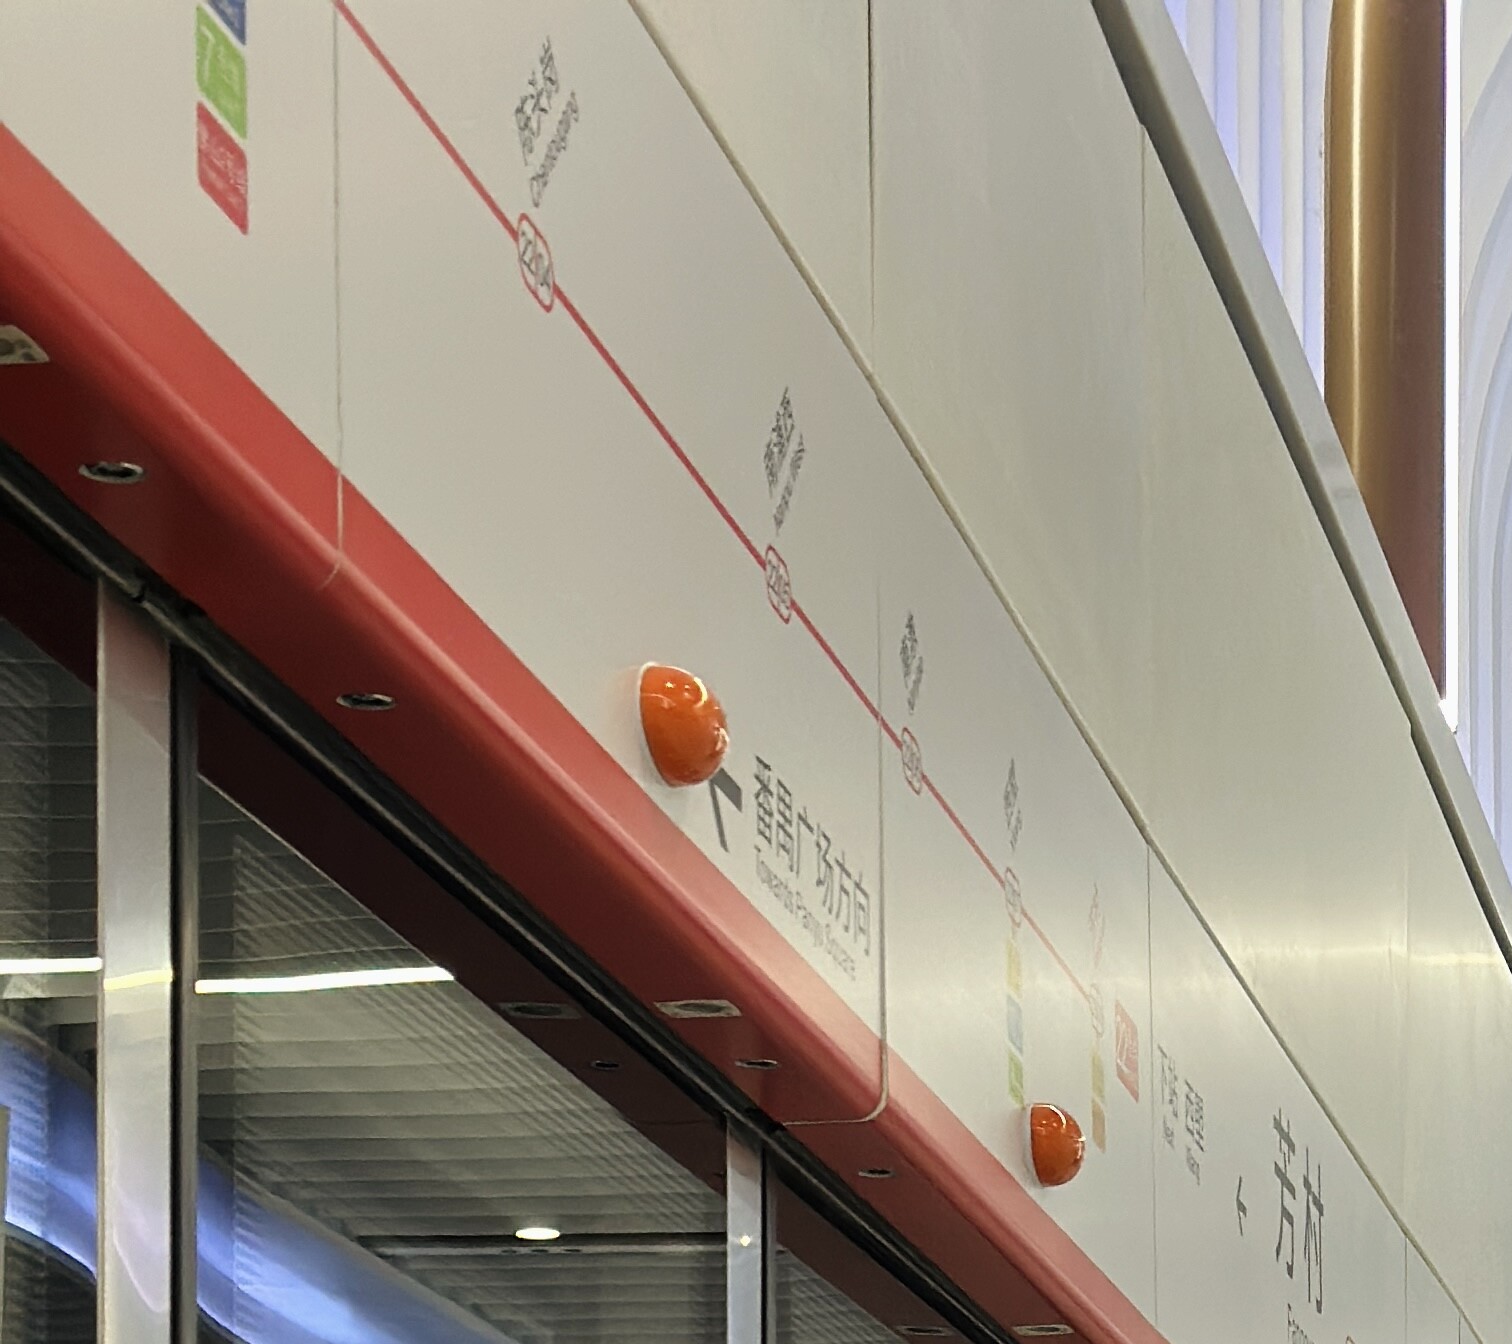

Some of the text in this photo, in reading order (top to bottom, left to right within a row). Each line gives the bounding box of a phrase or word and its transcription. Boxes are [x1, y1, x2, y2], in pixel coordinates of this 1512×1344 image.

[754, 754, 870, 957] 番禺广场方向
[1272, 1107, 1324, 1315] 芳村
